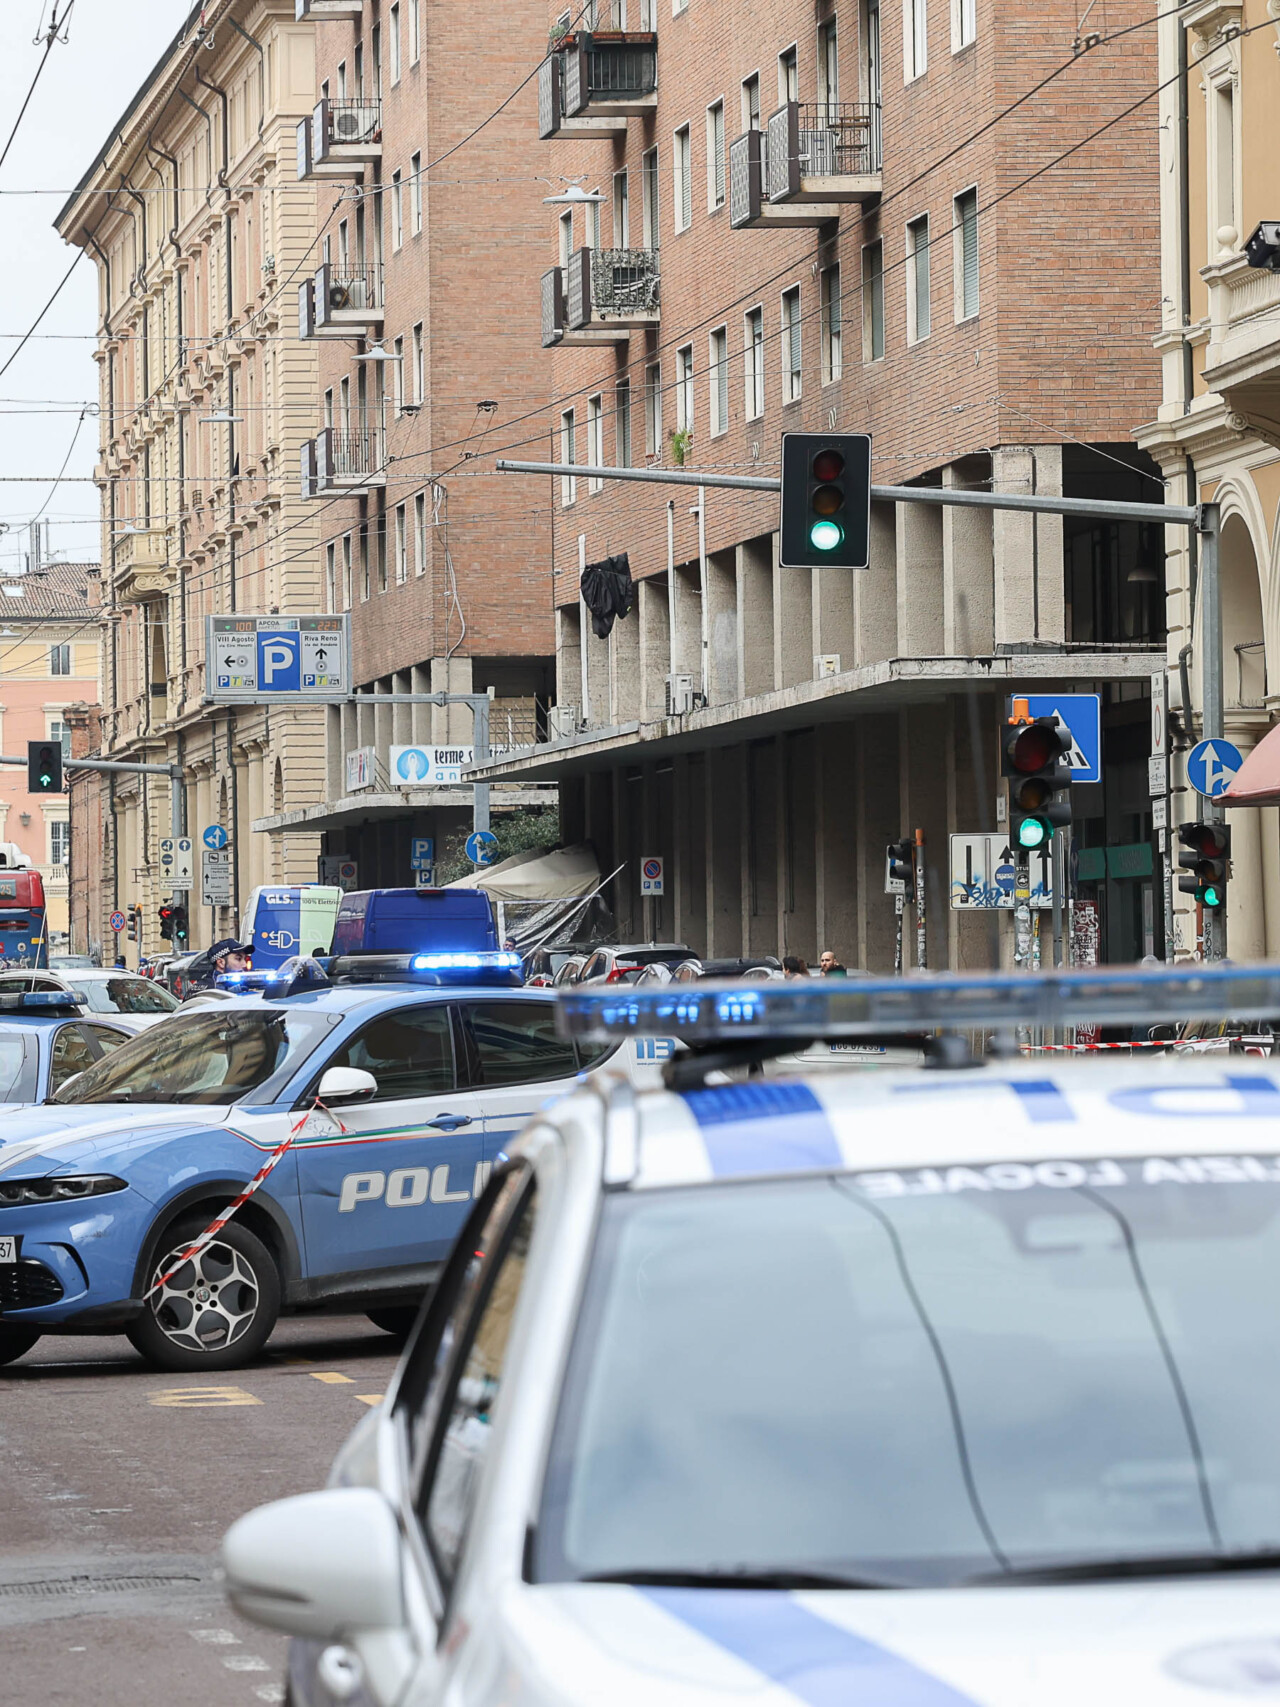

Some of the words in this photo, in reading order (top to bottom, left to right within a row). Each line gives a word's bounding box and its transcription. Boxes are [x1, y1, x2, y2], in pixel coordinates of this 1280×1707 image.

[235, 621, 252, 632] 100
[317, 620, 338, 631] 223
[264, 645, 293, 684] P
[220, 676, 228, 686] P
[305, 675, 313, 685] P
[434, 748, 464, 764] terme
[415, 840, 429, 858] P
[0, 884, 12, 895] 25
[634, 1038, 676, 1059] 113
